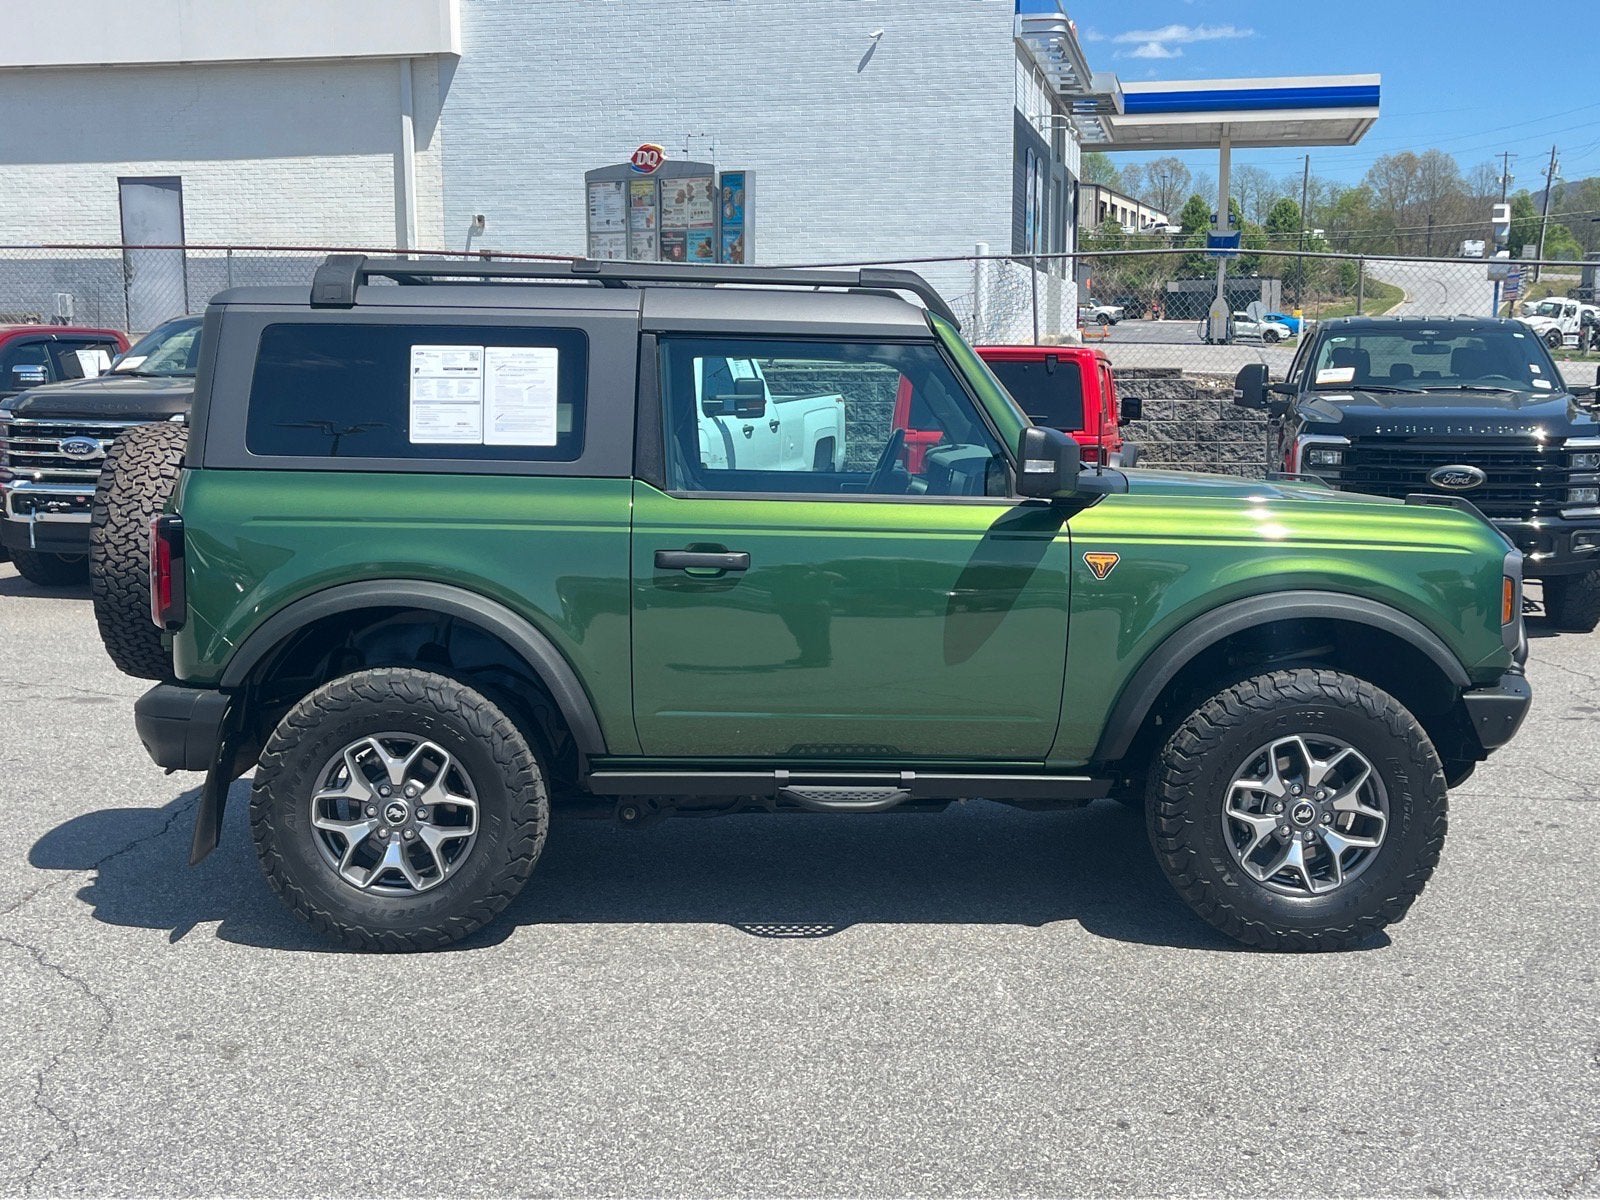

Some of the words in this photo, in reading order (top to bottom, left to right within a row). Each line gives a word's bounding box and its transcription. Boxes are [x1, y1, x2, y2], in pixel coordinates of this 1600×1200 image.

[636, 151, 658, 167] DQ
[67, 442, 89, 453] Ford
[1443, 472, 1472, 485] Ford
